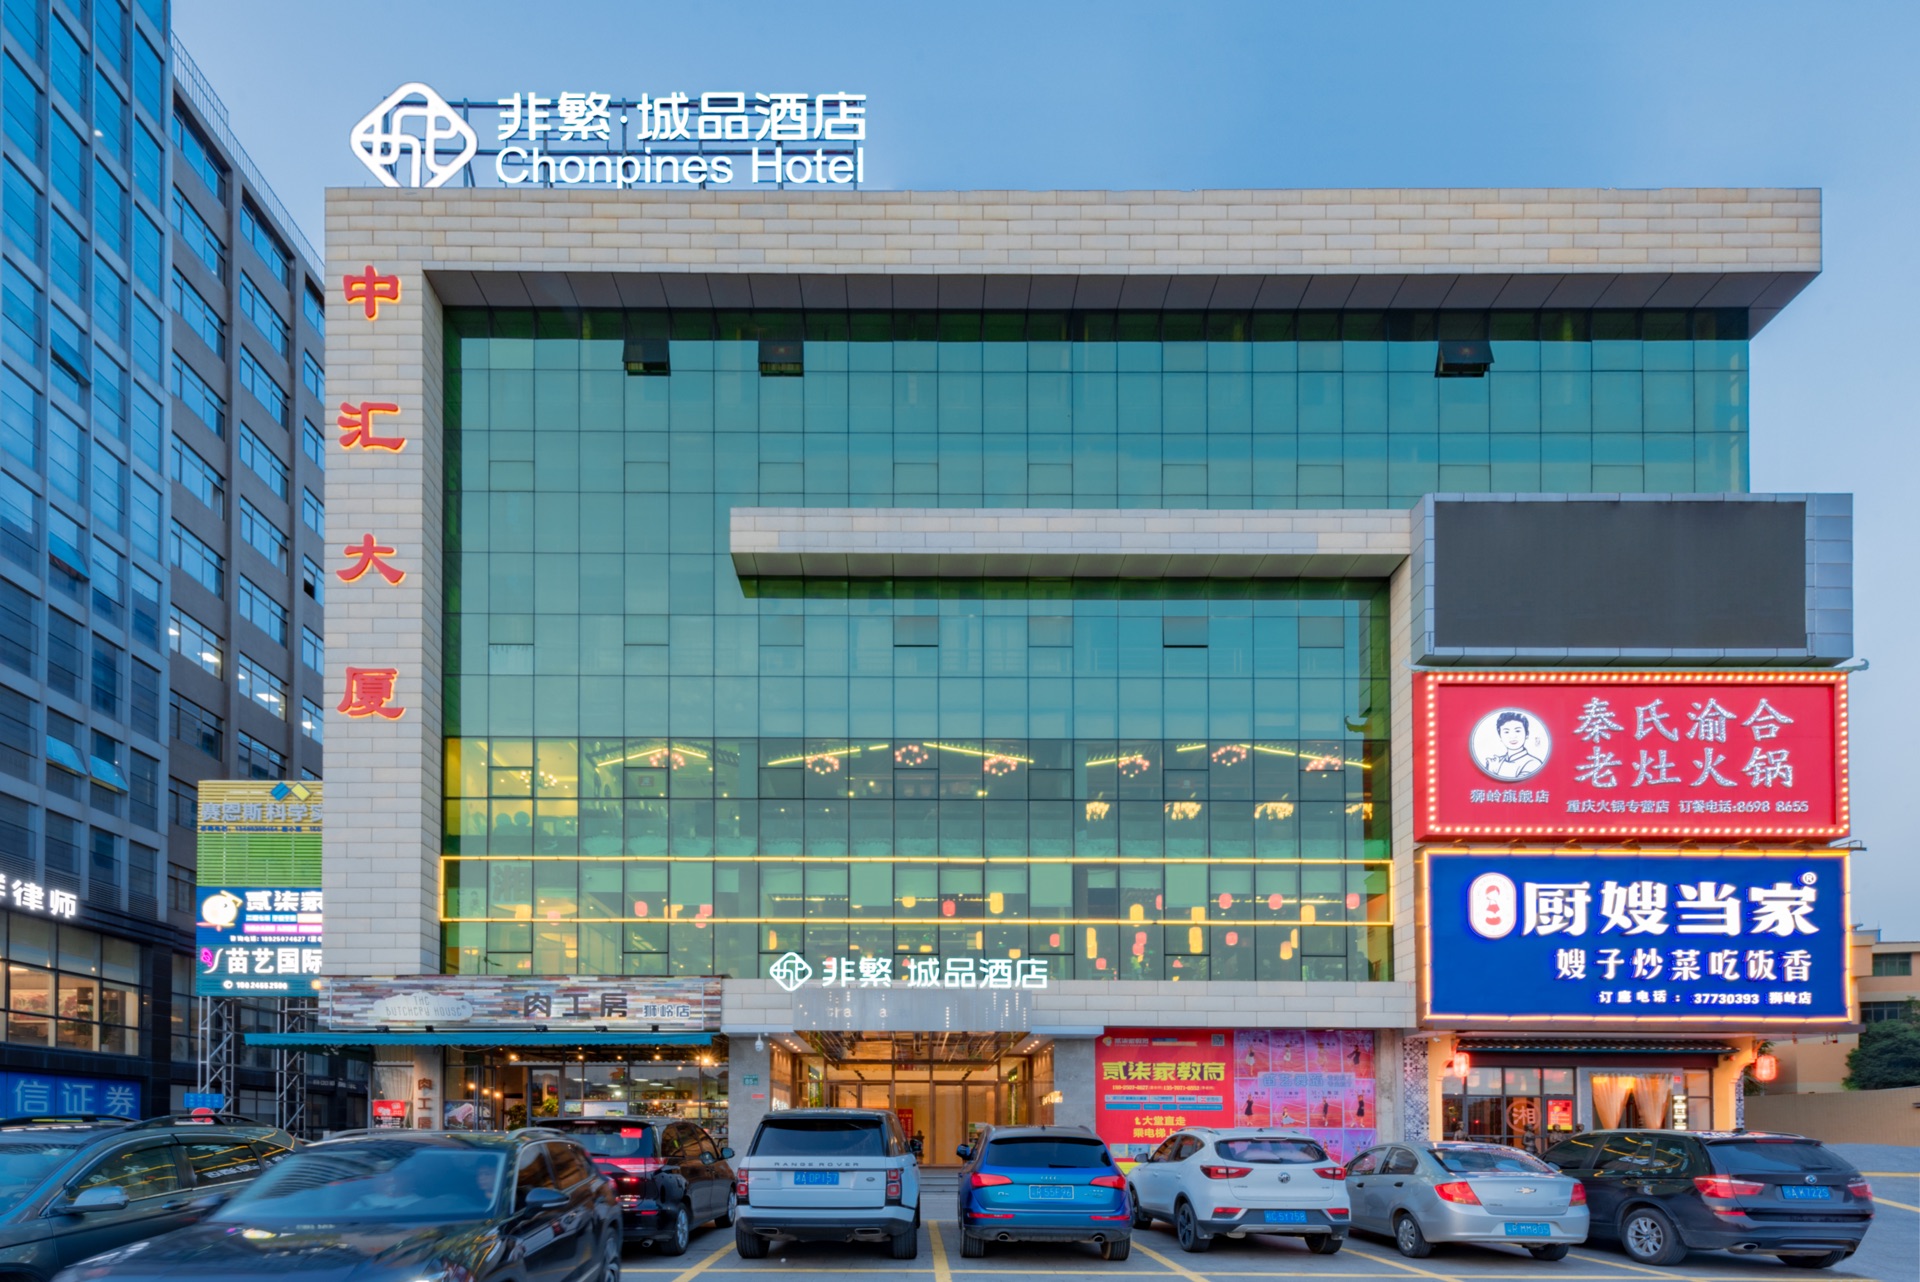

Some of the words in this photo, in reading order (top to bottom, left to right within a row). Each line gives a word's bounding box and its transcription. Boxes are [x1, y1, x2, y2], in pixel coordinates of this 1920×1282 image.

[496, 147, 733, 187] Chonpines
[752, 147, 864, 184] Hotel
[336, 264, 406, 720] 中汇大厦
[1573, 697, 1794, 743] 秦氏渝合
[1574, 746, 1793, 788] 老灶火锅
[1470, 789, 1549, 803] 狮岭旗舰店
[1566, 799, 1669, 813] 重庆火锅专营店
[1522, 881, 1820, 937] 厨嫂当家
[225, 947, 322, 974] 苗艺国际
[1555, 948, 1812, 982] 嫂子炒菜吃饭香
[524, 992, 627, 1018] 肉工房
[642, 1004, 691, 1018] 狮岭店
[1693, 993, 1760, 1004] 37730393
[1769, 992, 1812, 1004] 狮岭店
[15, 1080, 134, 1115] 信证券
[1142, 1116, 1186, 1126] 大堂直走
